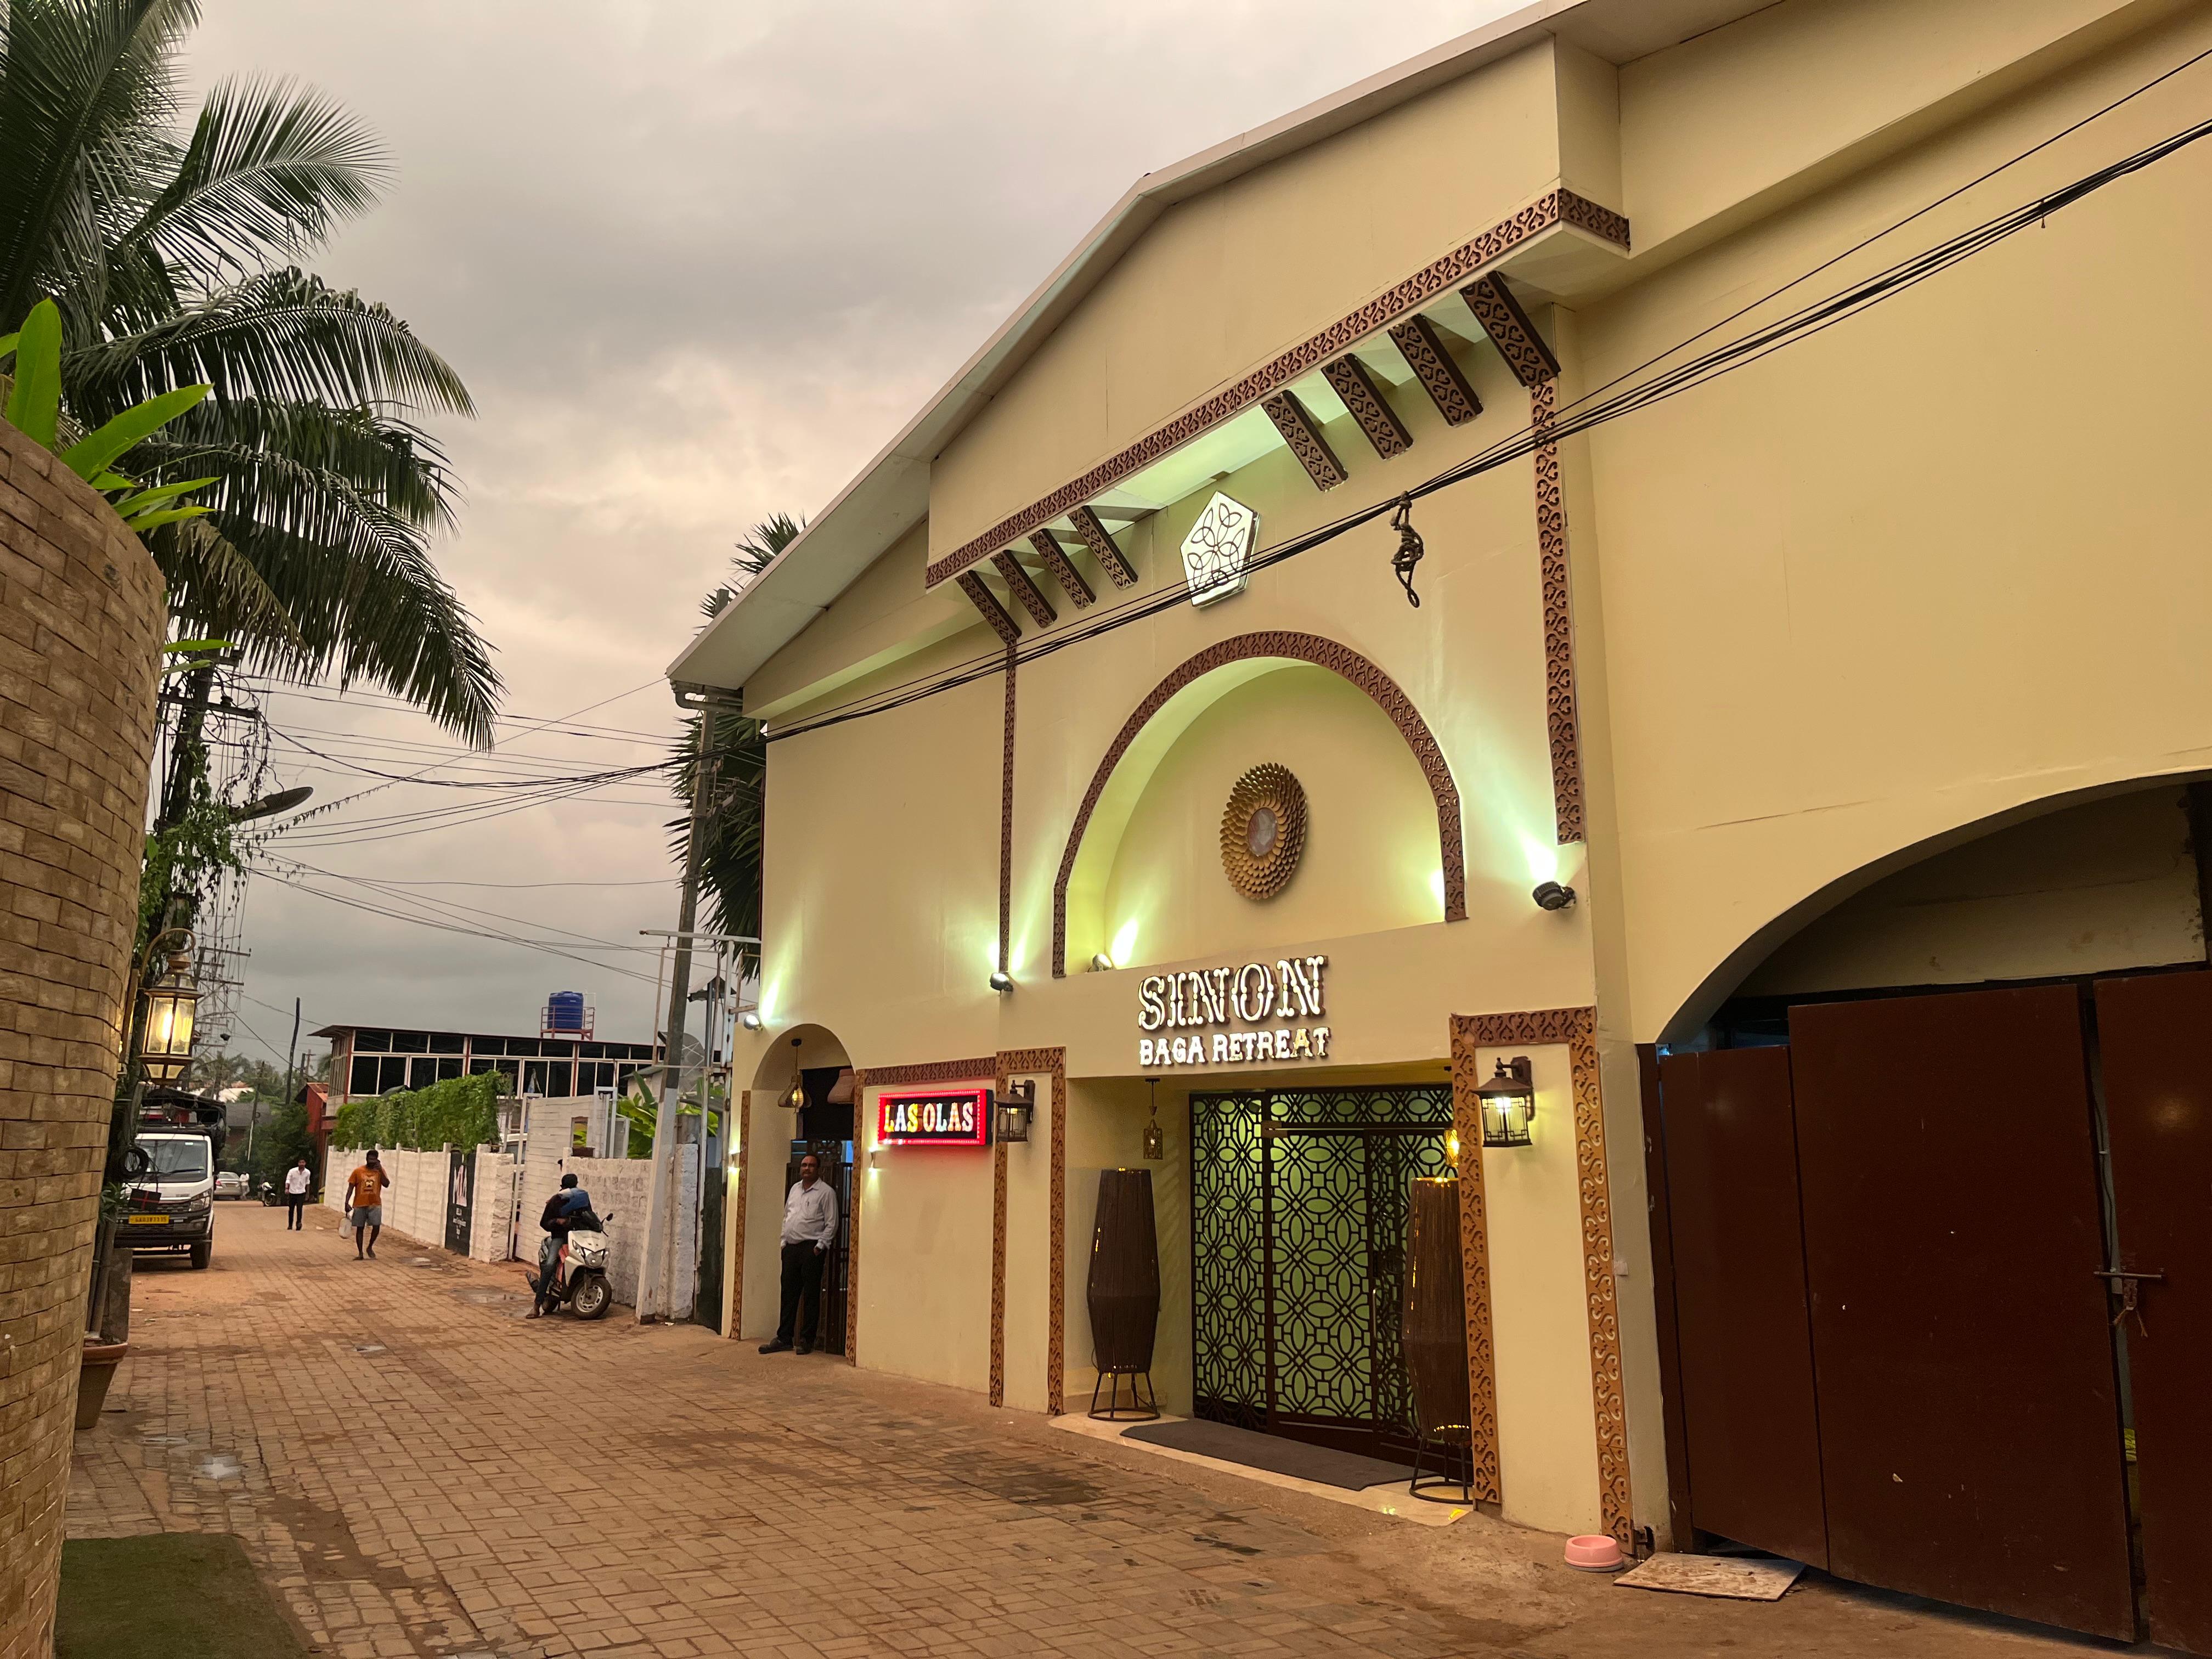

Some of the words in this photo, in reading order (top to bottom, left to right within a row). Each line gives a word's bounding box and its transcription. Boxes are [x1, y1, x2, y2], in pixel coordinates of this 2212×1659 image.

[1138, 955, 1329, 1031] SINON
[1139, 1036, 1207, 1066] BAGA
[1211, 1027, 1330, 1063] RETREAT
[884, 1103, 919, 1132] LAS
[922, 1102, 974, 1132] OLAS
